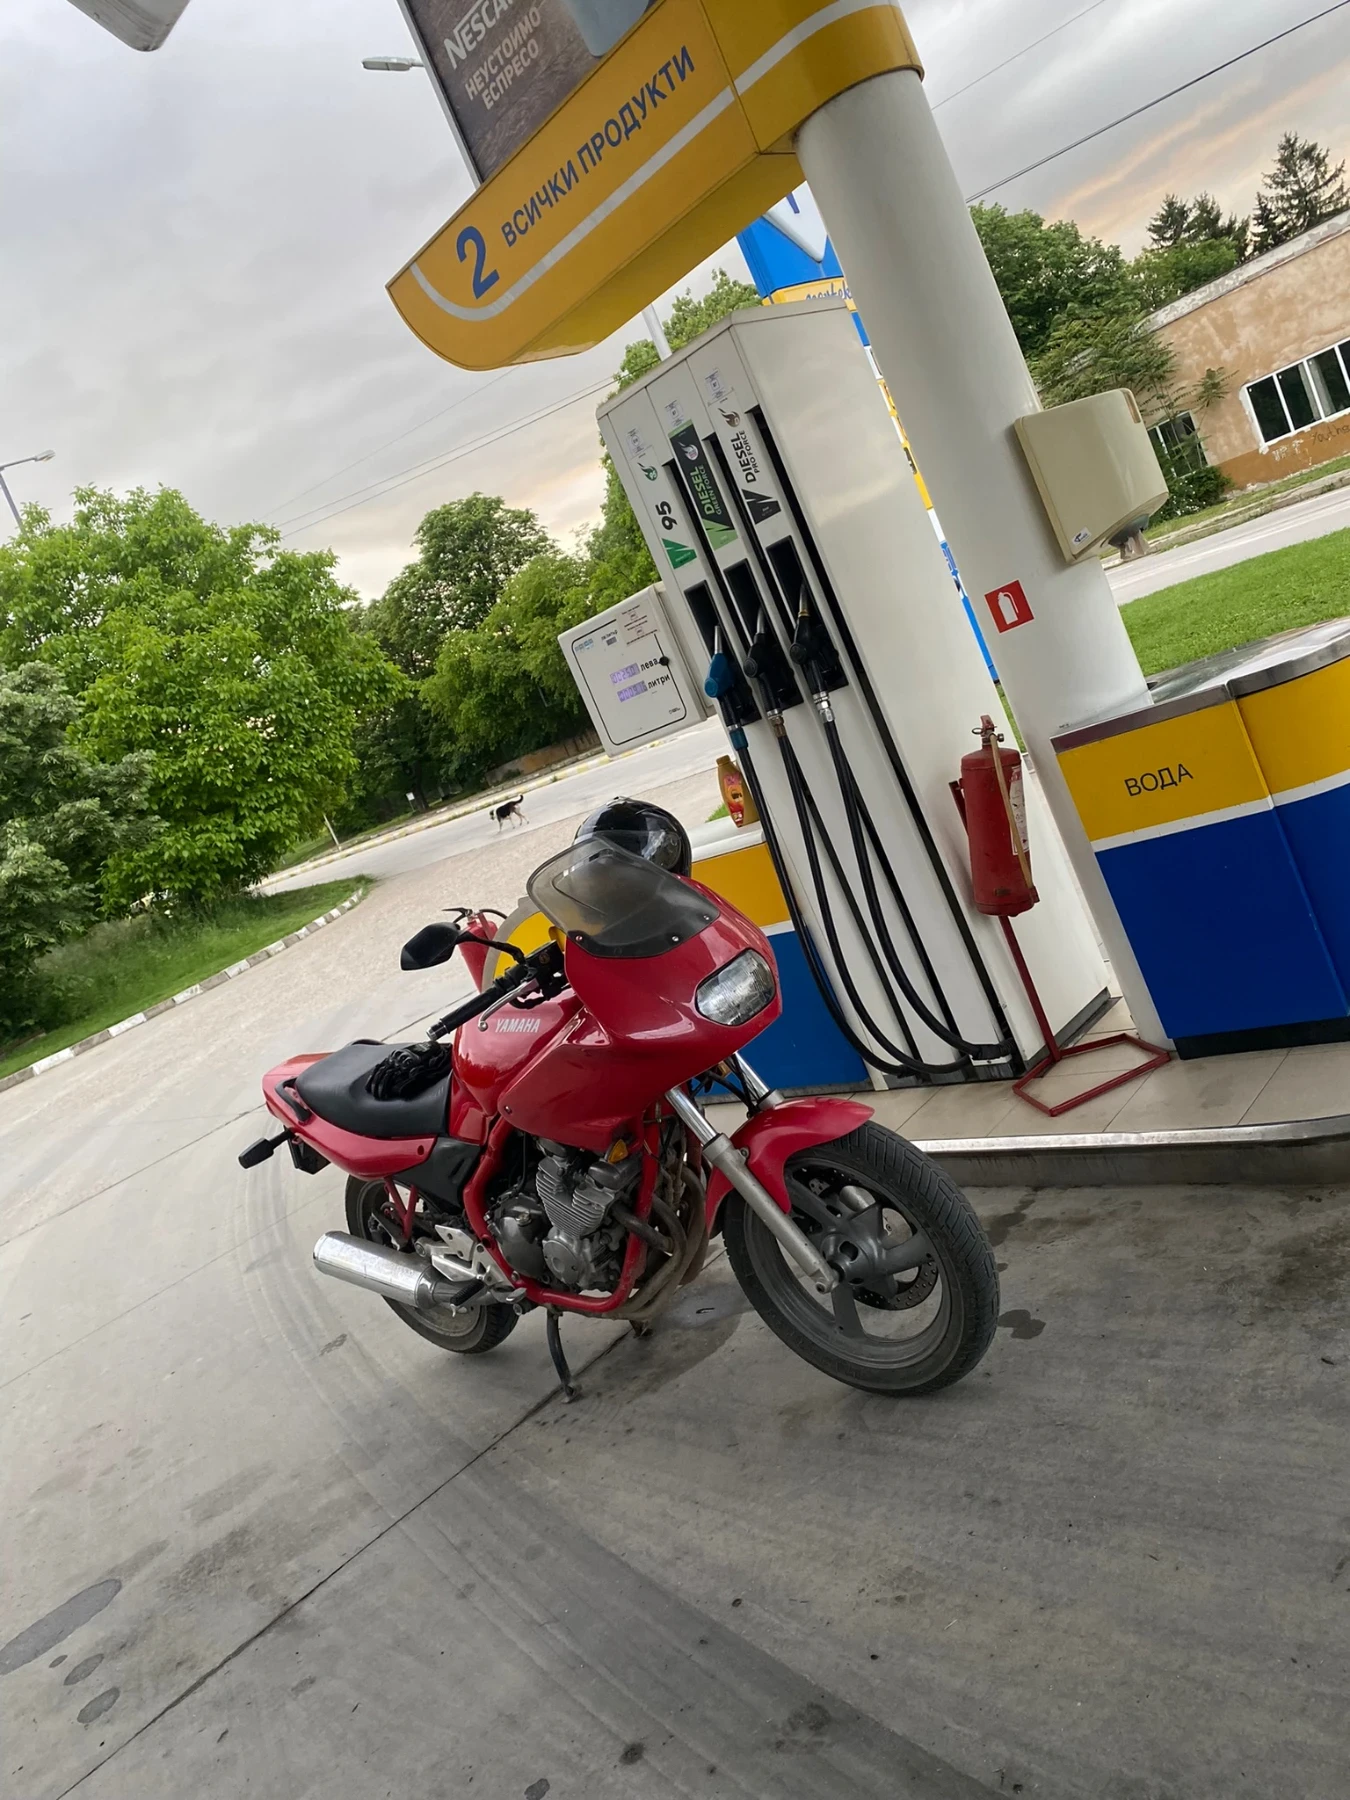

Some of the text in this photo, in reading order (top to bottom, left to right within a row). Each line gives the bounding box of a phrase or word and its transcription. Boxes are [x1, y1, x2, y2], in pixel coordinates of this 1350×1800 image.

[444, 0, 513, 70] NESCA
[465, 6, 541, 101] НЕУСТОИМО
[482, 38, 539, 110] ЕСПРЕСО
[456, 45, 696, 299] 2 ВСИЧКИ ПРОДУКТИ
[731, 432, 756, 483] DIESEL
[739, 430, 760, 473] PRO FORCE
[690, 466, 715, 515] DIESEL
[699, 465, 722, 516] GREEN FORCE
[655, 501, 678, 531] 95
[640, 657, 659, 672] лева
[647, 674, 671, 689] литри
[1124, 763, 1194, 797] ВОДА
[495, 1018, 541, 1033] YAMAHA
